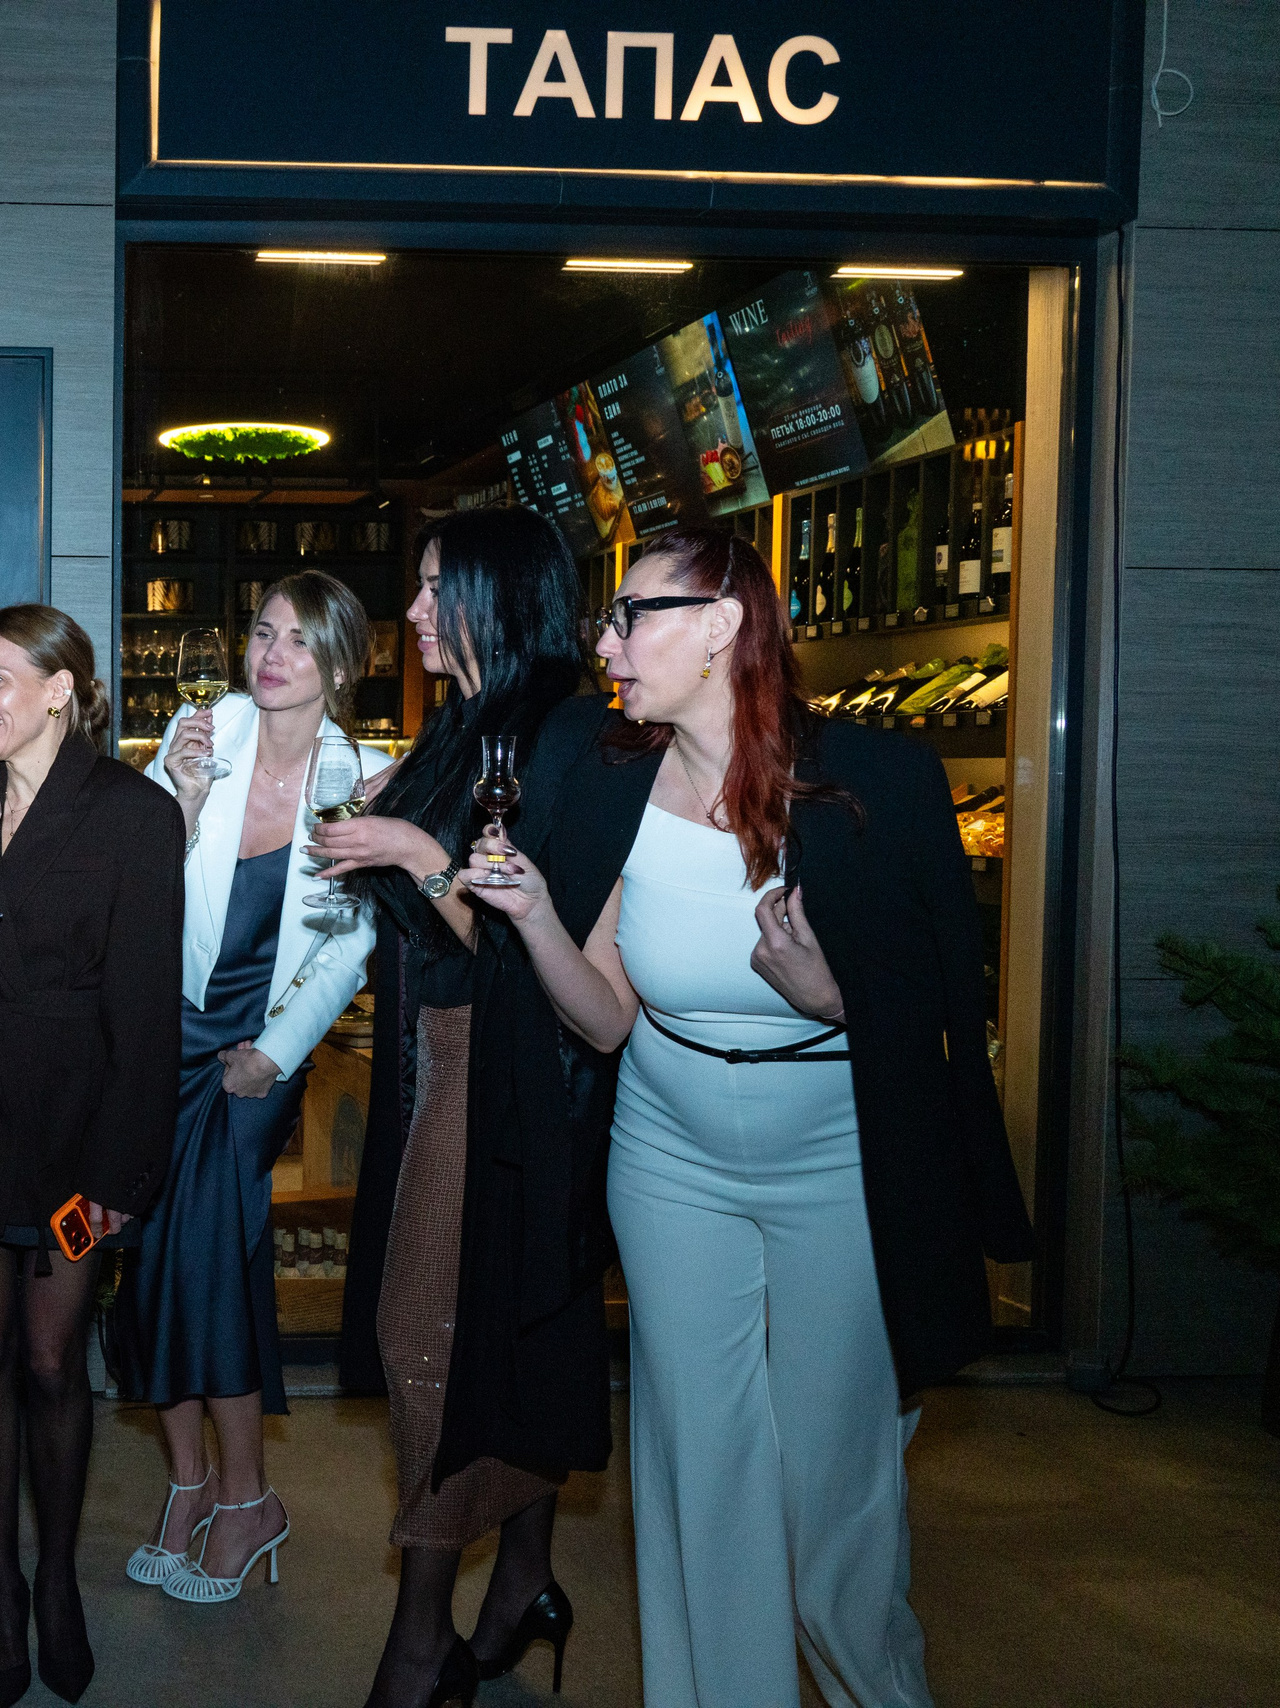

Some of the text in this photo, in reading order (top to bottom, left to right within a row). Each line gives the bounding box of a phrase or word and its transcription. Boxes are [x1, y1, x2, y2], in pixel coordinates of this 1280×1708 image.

[446, 26, 840, 125] ТАПАС
[728, 298, 769, 337] WINE
[770, 403, 841, 440] ПЕТЪК 18:00-20:00
